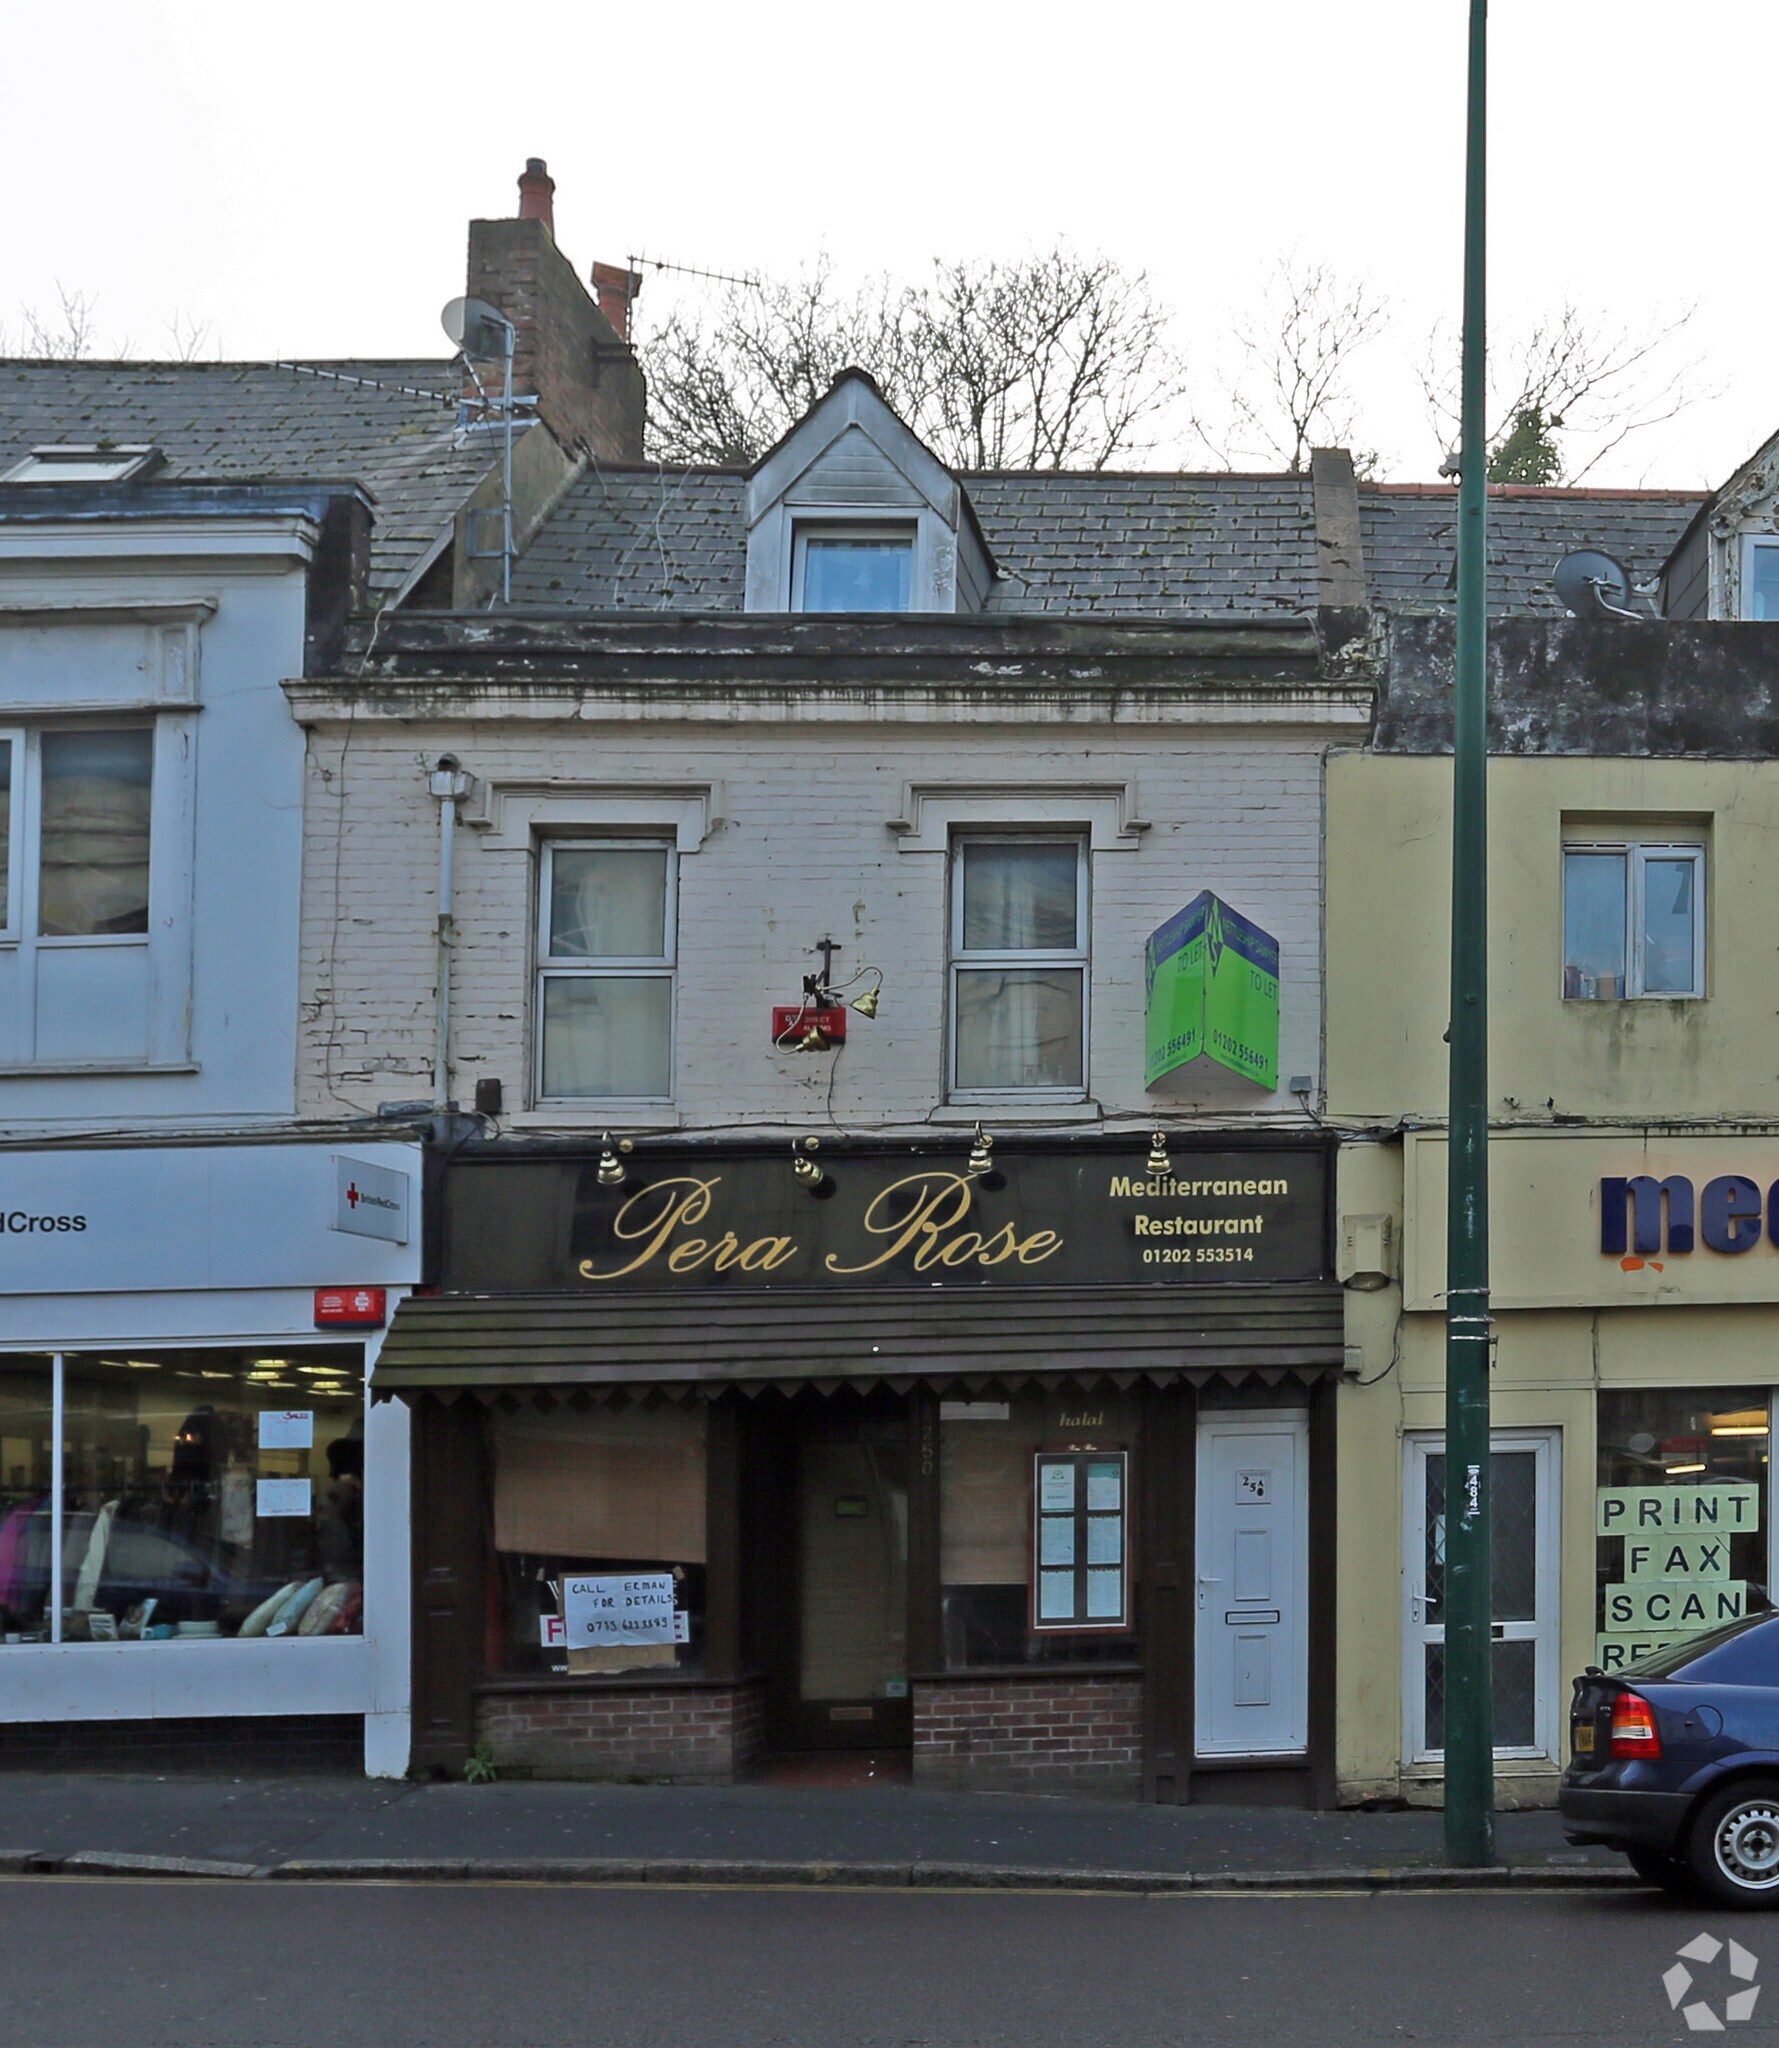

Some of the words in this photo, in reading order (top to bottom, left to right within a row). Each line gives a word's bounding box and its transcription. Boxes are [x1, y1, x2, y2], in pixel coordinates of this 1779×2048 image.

[1178, 952, 1188, 971] TO
[1190, 941, 1204, 965] LET
[1250, 970, 1262, 991] TO
[1264, 980, 1278, 1000] LET
[1167, 1028, 1196, 1057] 556491
[1213, 1029, 1238, 1055] 01202
[1239, 1044, 1269, 1072] 556491
[1109, 1175, 1288, 1197] Mediterranean
[579, 1176, 797, 1280] Pera
[825, 1172, 1063, 1273] Rose
[1134, 1215, 1264, 1235] Restaurant
[1600, 1175, 1779, 1255] me
[1143, 1249, 1191, 1263] 01202
[1196, 1248, 1254, 1263] 553514
[1059, 1411, 1104, 1427] halal
[921, 1425, 933, 1475] 250
[1603, 1496, 1750, 1528] PRINT
[1630, 1544, 1721, 1574] FAX
[572, 1583, 605, 1594] CALL
[624, 1581, 665, 1592] ERMAN
[593, 1598, 615, 1608] FOR
[626, 1594, 673, 1606] DETAILS
[1611, 1592, 1741, 1622] SCAN
